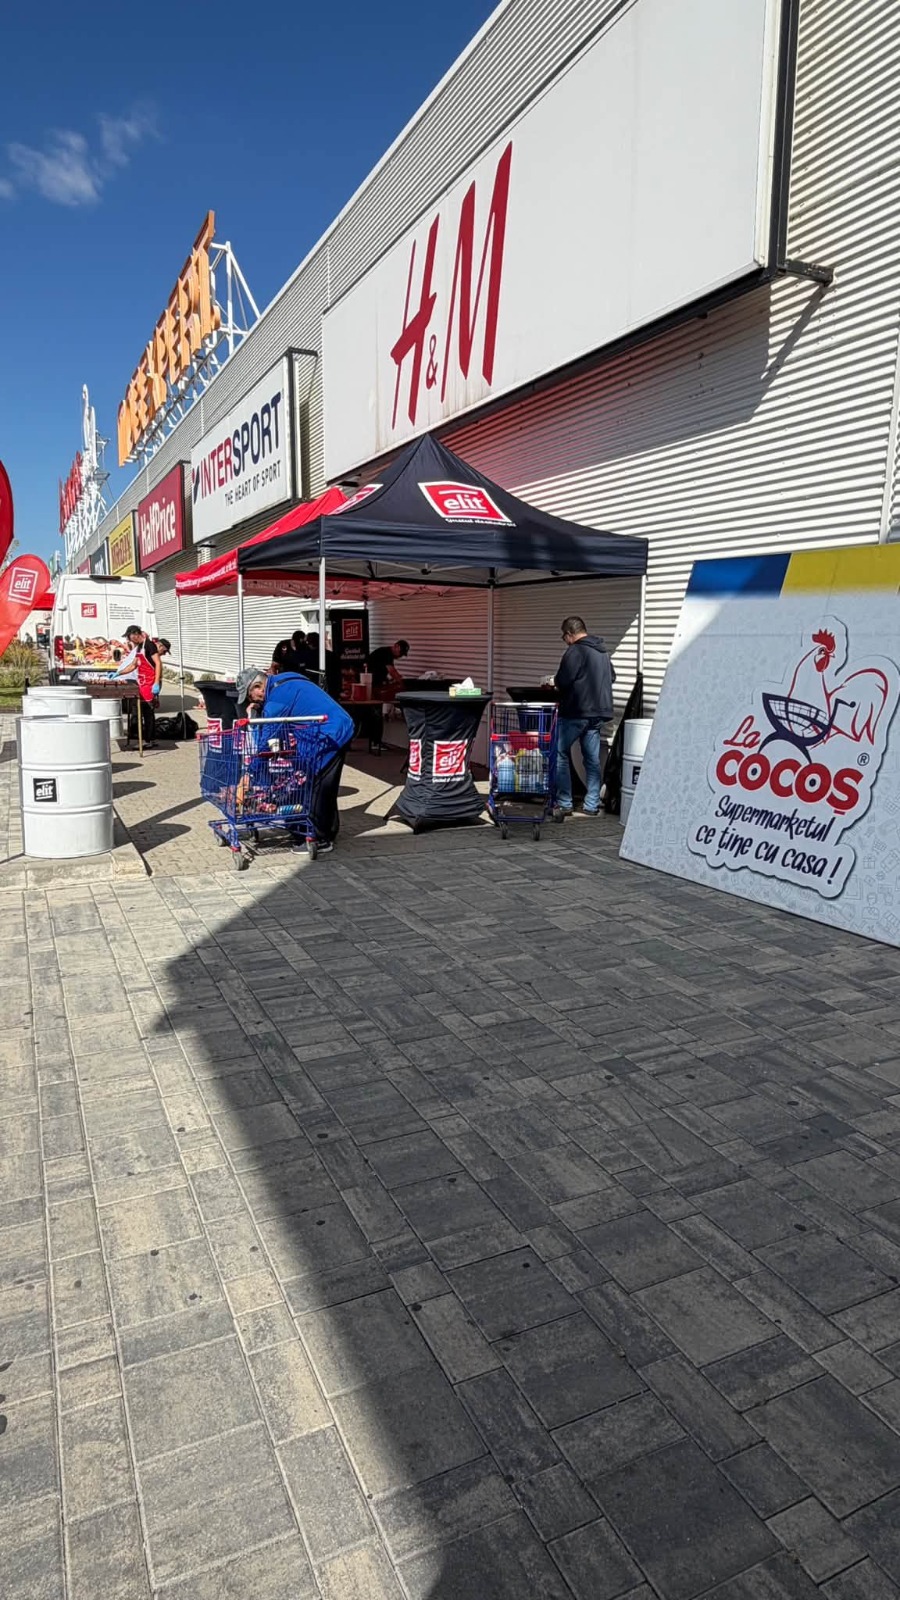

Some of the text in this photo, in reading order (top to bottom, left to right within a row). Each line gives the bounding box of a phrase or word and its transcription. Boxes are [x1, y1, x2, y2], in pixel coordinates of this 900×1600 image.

[390, 140, 513, 431] H&M
[200, 391, 281, 499] INTERSPORT
[224, 460, 281, 507] THE HEART OF SPORT
[443, 494, 486, 510] elit
[140, 497, 176, 557] HalfPrice
[14, 577, 32, 589] elit
[723, 715, 761, 748] La
[35, 784, 54, 797] elit
[715, 795, 836, 842] Supermarketul
[695, 825, 716, 844] ce
[754, 841, 780, 864] cu
